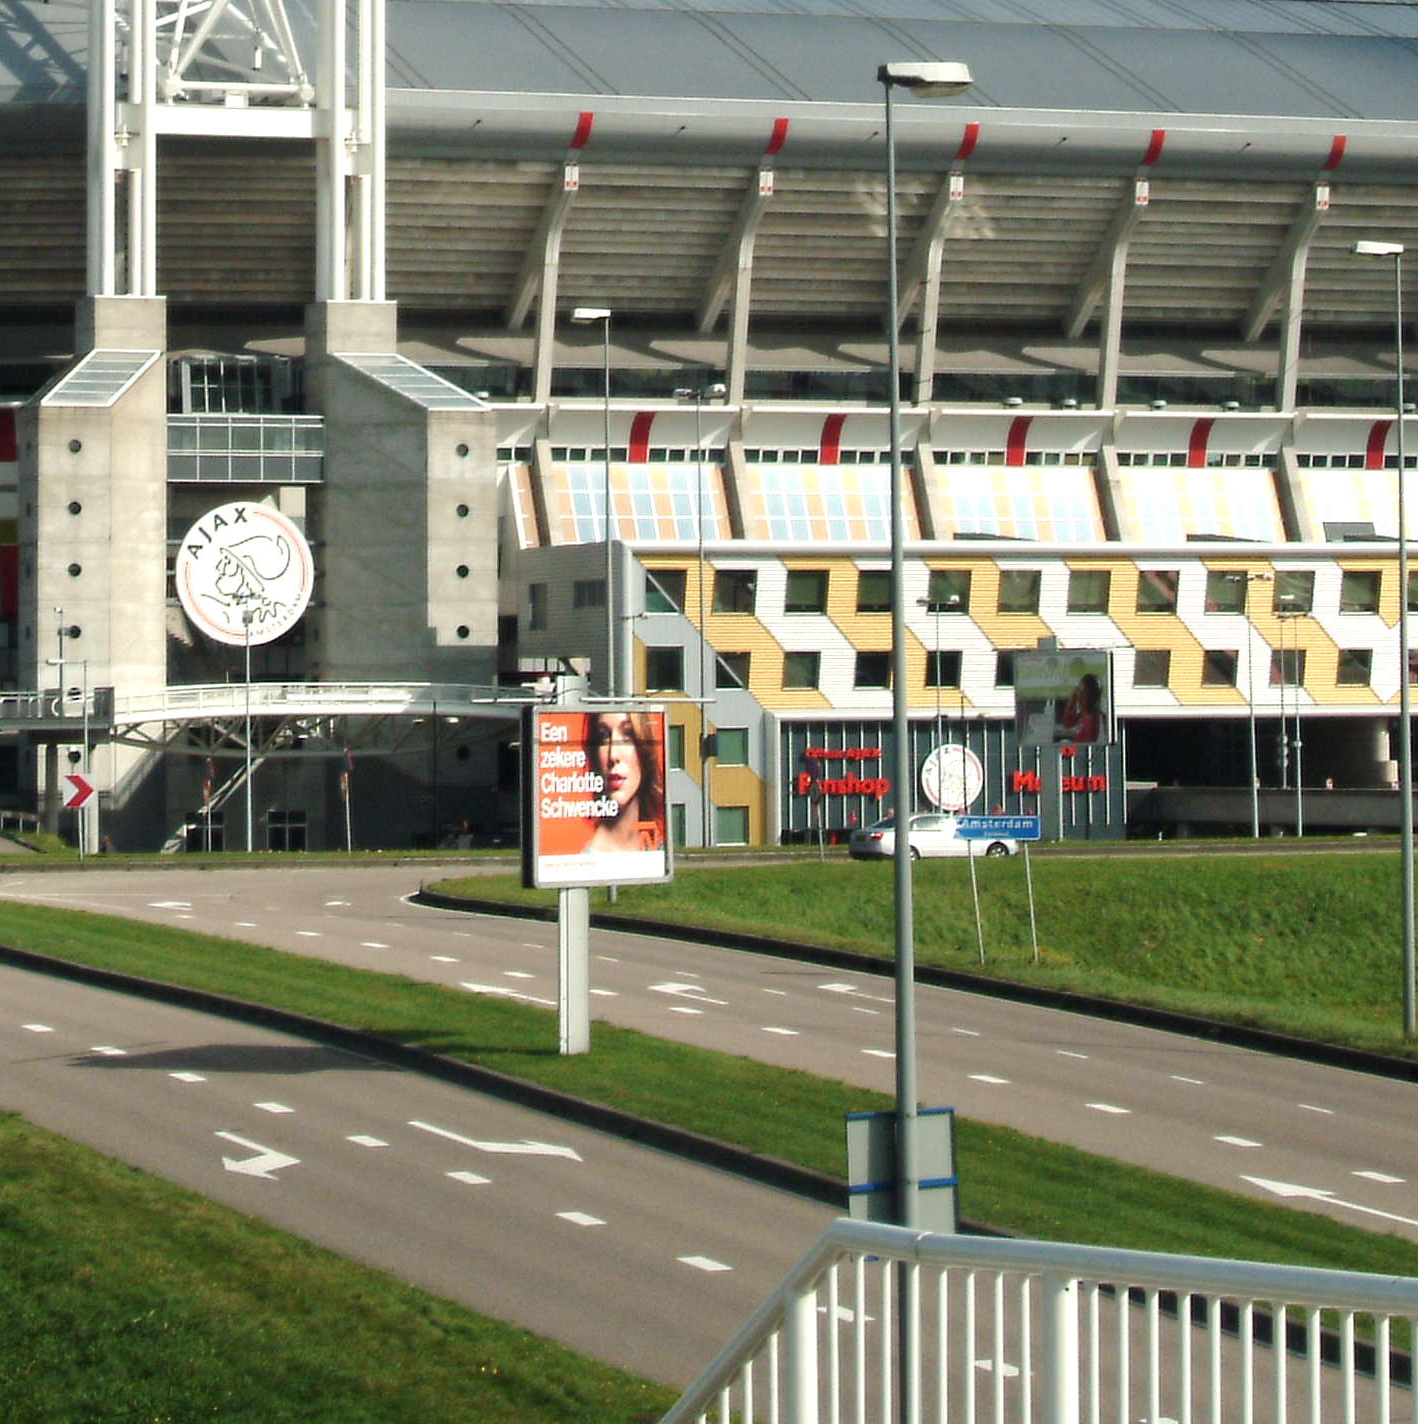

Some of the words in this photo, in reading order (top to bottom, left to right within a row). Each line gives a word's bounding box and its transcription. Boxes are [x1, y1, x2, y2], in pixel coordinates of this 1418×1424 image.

[187, 507, 248, 560] AJAX
[541, 723, 568, 742] Een
[540, 747, 586, 769] zekere
[541, 771, 604, 793] Charlotte
[798, 772, 890, 800] Fnshop
[1012, 770, 1106, 792] Mueum
[541, 796, 619, 818] Schwencke
[961, 818, 1033, 829] Amsterdam
